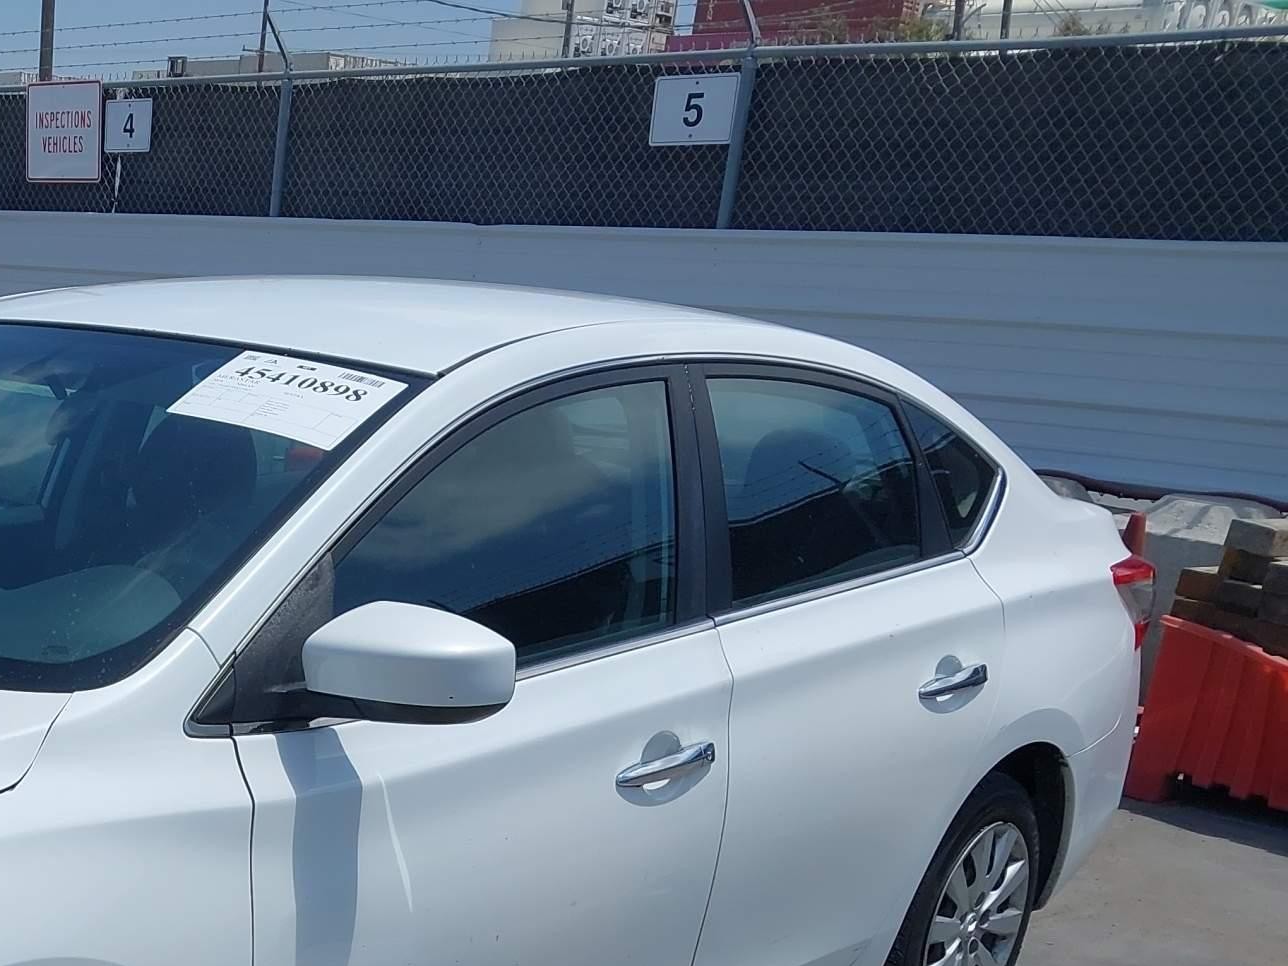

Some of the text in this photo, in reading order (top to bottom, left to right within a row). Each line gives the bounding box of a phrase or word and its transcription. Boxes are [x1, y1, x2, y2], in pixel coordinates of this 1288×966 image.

[35, 110, 92, 129] INSPECTIONS
[682, 92, 705, 128] 5
[122, 112, 135, 139] 4
[42, 135, 84, 154] VEHICLES
[234, 365, 368, 403] 45410898
